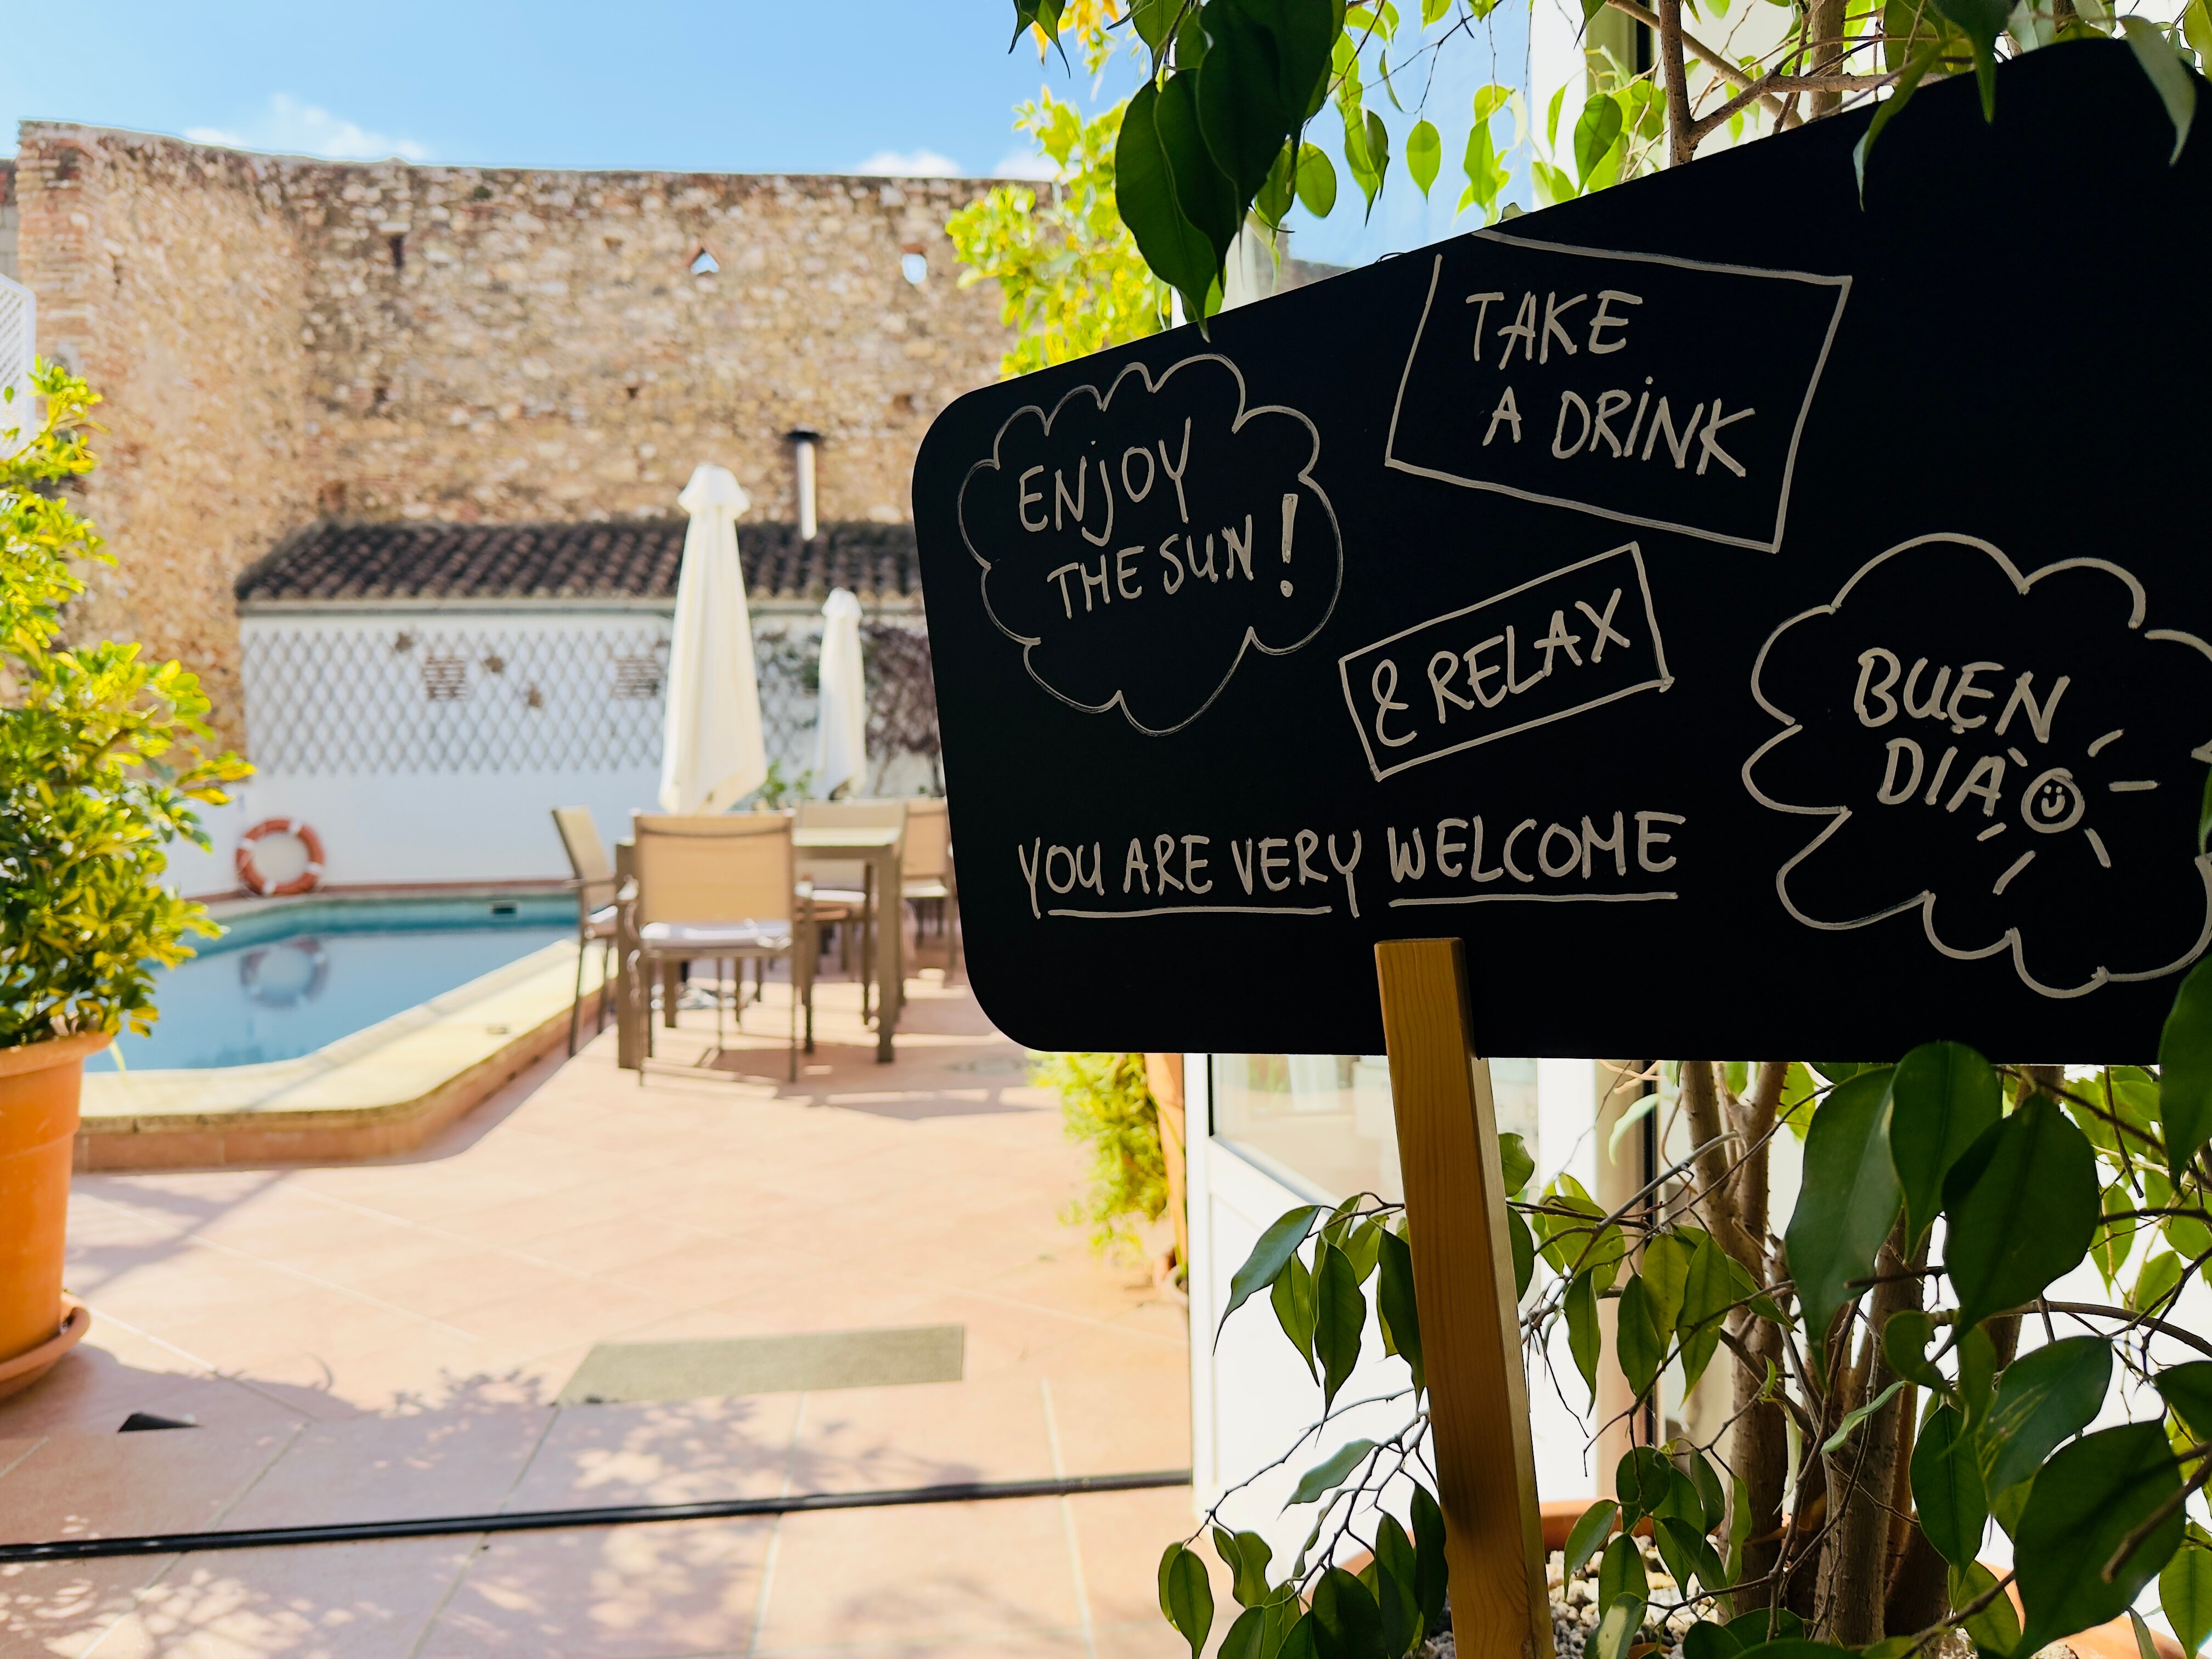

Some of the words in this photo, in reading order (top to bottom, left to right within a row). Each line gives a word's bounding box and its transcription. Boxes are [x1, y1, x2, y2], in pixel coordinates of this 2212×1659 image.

[1466, 290, 1644, 371] TAKE
[1482, 386, 1522, 447] A
[1047, 545, 1146, 619] THE
[1372, 658, 1418, 747] &
[1427, 588, 1631, 724] RELAX
[1018, 837, 1105, 919] YOU
[1123, 833, 1214, 896] ARE
[1231, 828, 1362, 919] VERY
[1387, 810, 1687, 884] WELCOME
